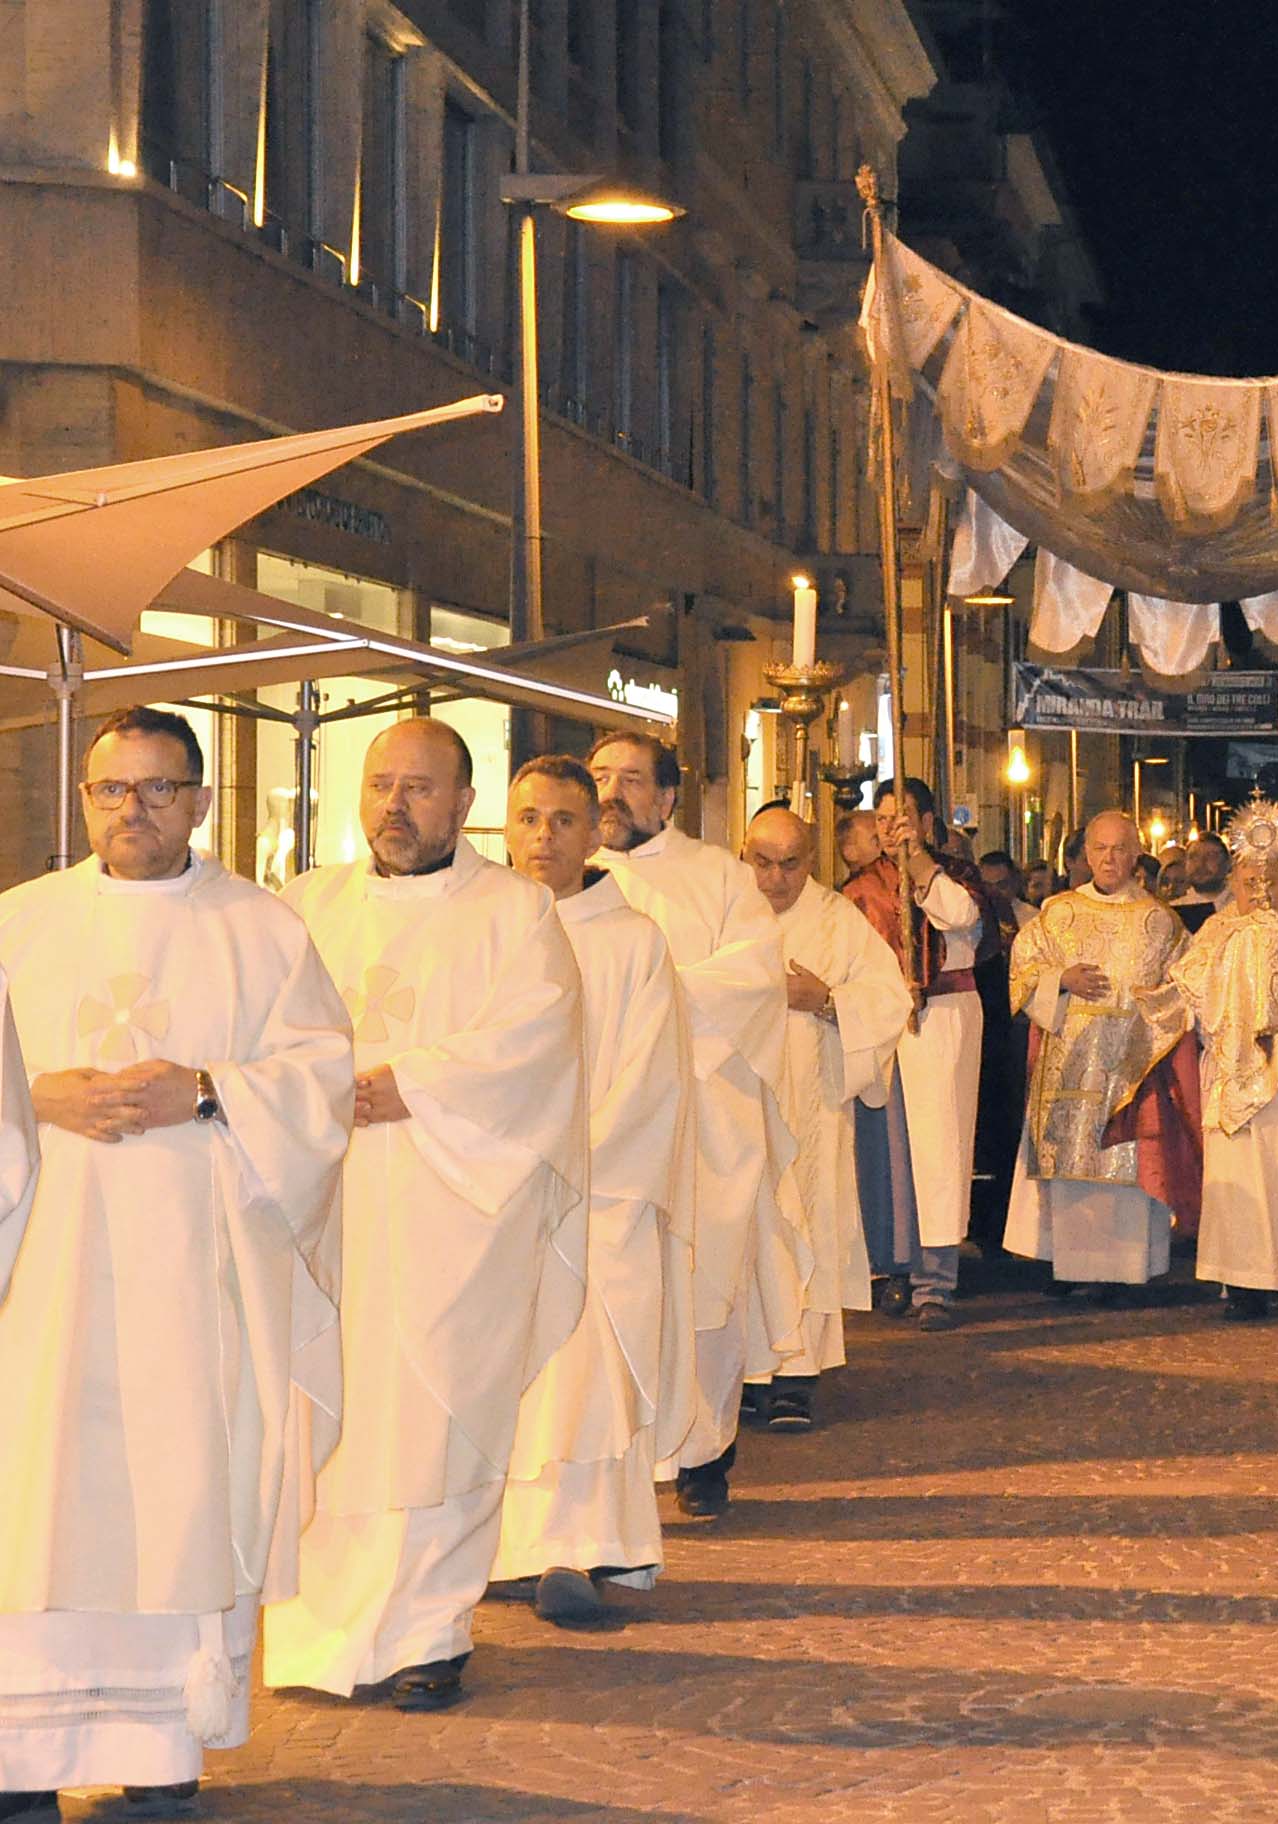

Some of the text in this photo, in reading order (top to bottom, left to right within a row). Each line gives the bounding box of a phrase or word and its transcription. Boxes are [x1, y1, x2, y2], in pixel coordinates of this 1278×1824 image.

[1036, 695, 1165, 720] MIRANDA TRAIL
[1231, 694, 1246, 705] TRE
